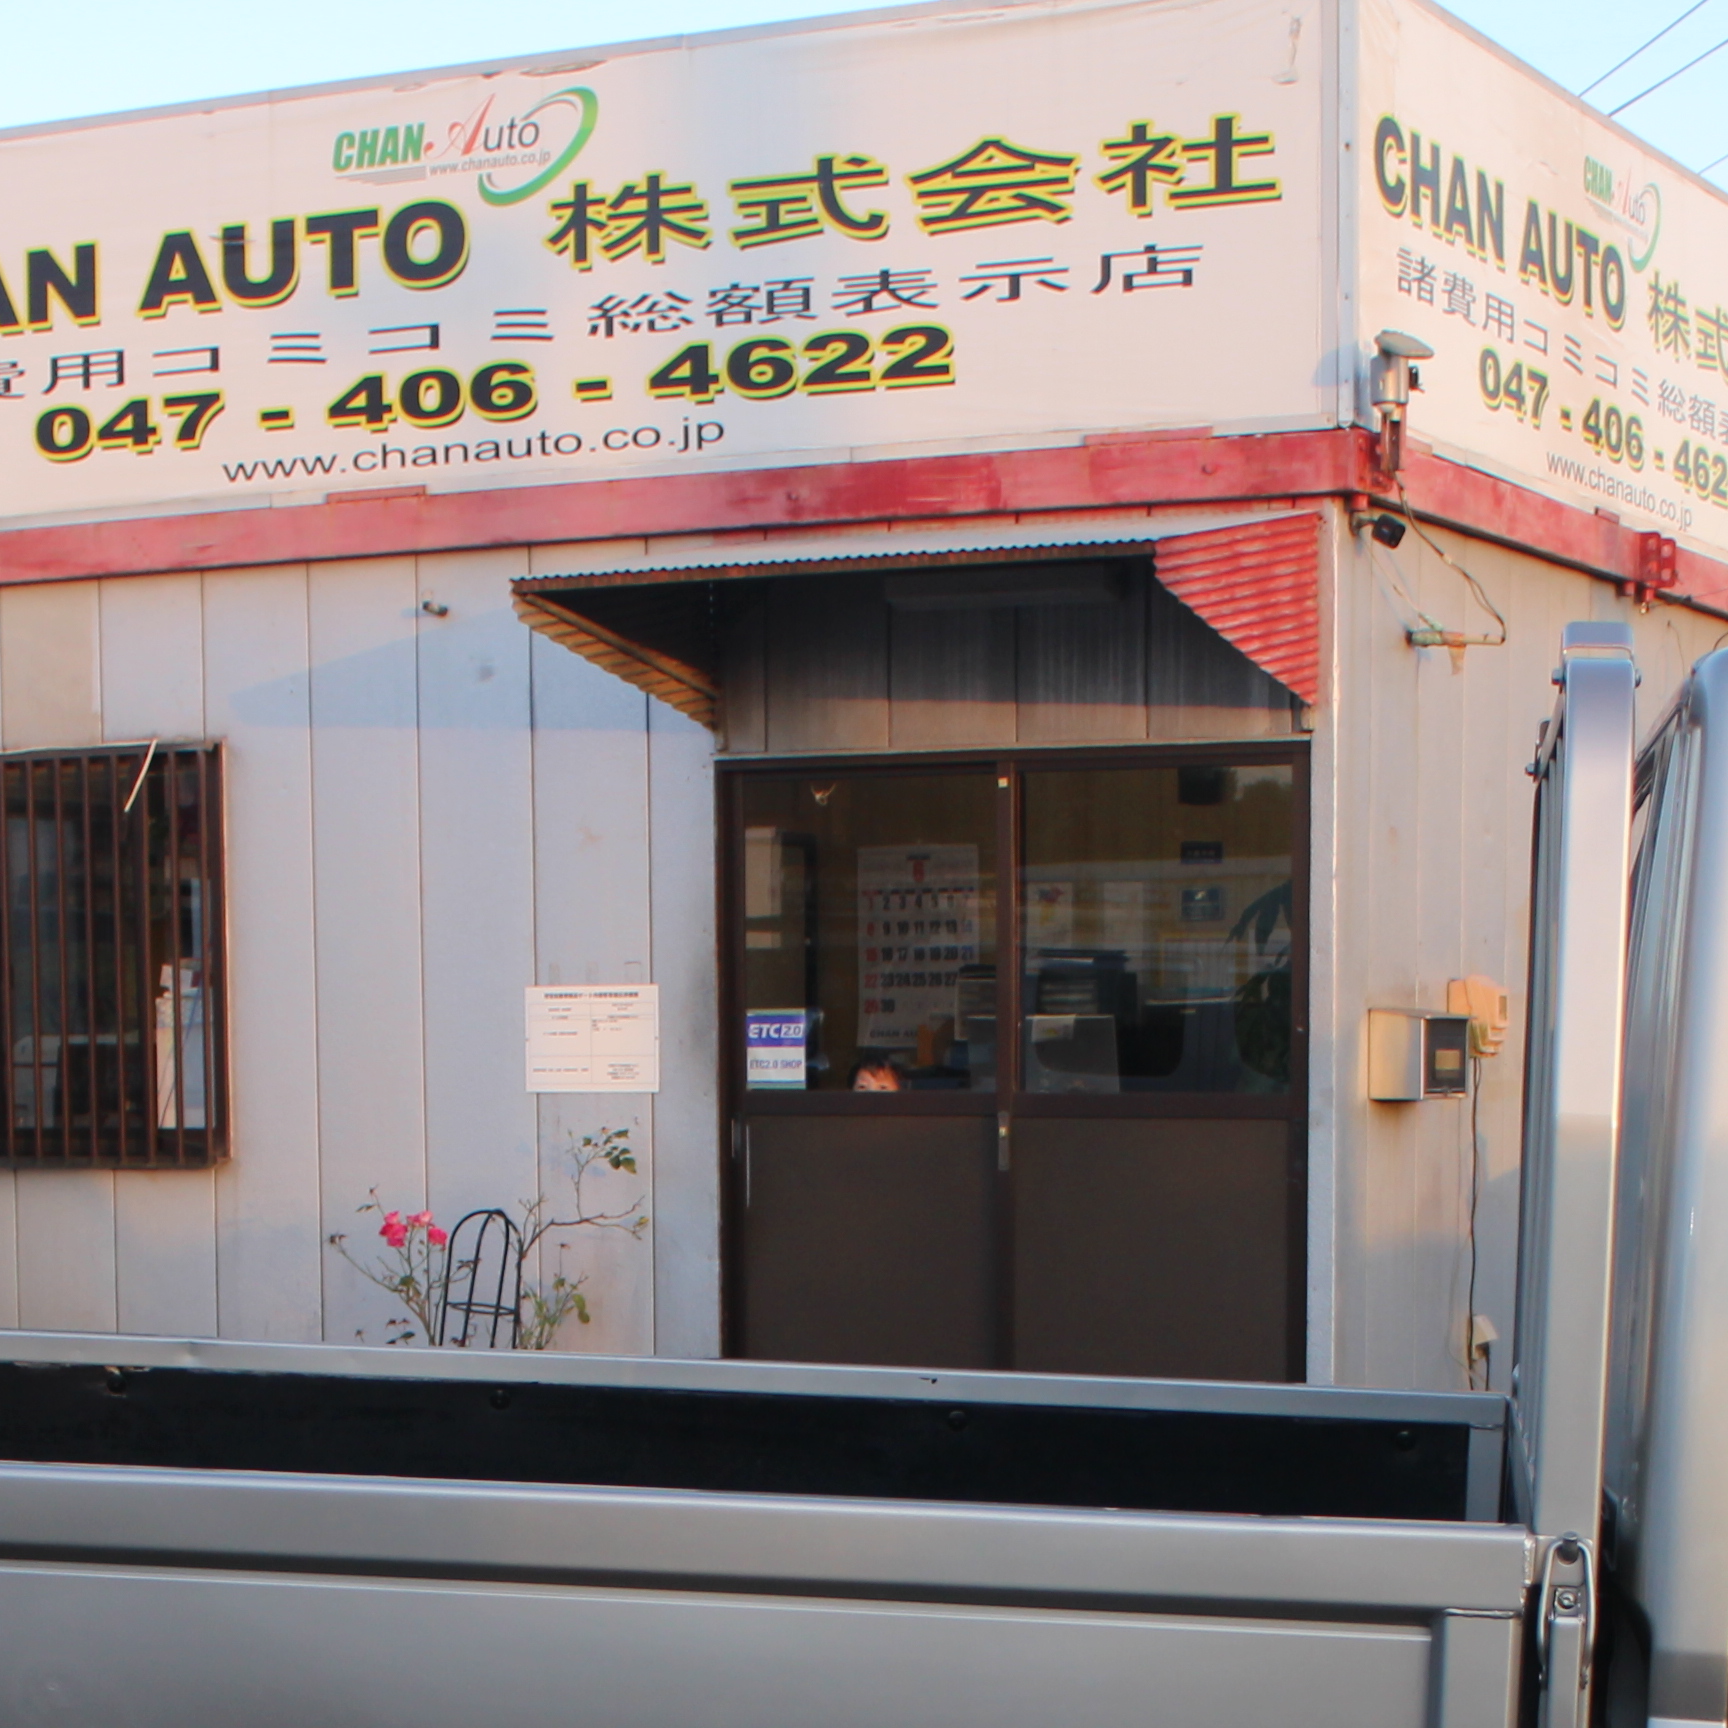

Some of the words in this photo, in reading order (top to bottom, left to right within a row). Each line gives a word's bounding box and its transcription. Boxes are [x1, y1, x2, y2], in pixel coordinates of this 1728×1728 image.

[332, 122, 426, 172] CHAN
[429, 149, 552, 176] www.chanauto.co.jp
[136, 199, 469, 319] AUTO
[547, 112, 1283, 271] 株式会社
[1374, 114, 1506, 272] CHAN
[1519, 198, 1626, 332] AUTO
[35, 388, 226, 461] 047
[326, 359, 538, 431] 406
[648, 323, 957, 405] 4622
[1478, 346, 1550, 429] 047
[1582, 396, 1645, 470] 406
[223, 415, 725, 483] www.chanauto.co.jp
[1545, 448, 1694, 532] www.chanauto.co.jp
[748, 1022, 781, 1039] ETC
[781, 1023, 804, 1039] 2.0
[749, 1058, 779, 1070] ETC2.0
[780, 1058, 803, 1070] SHOP
